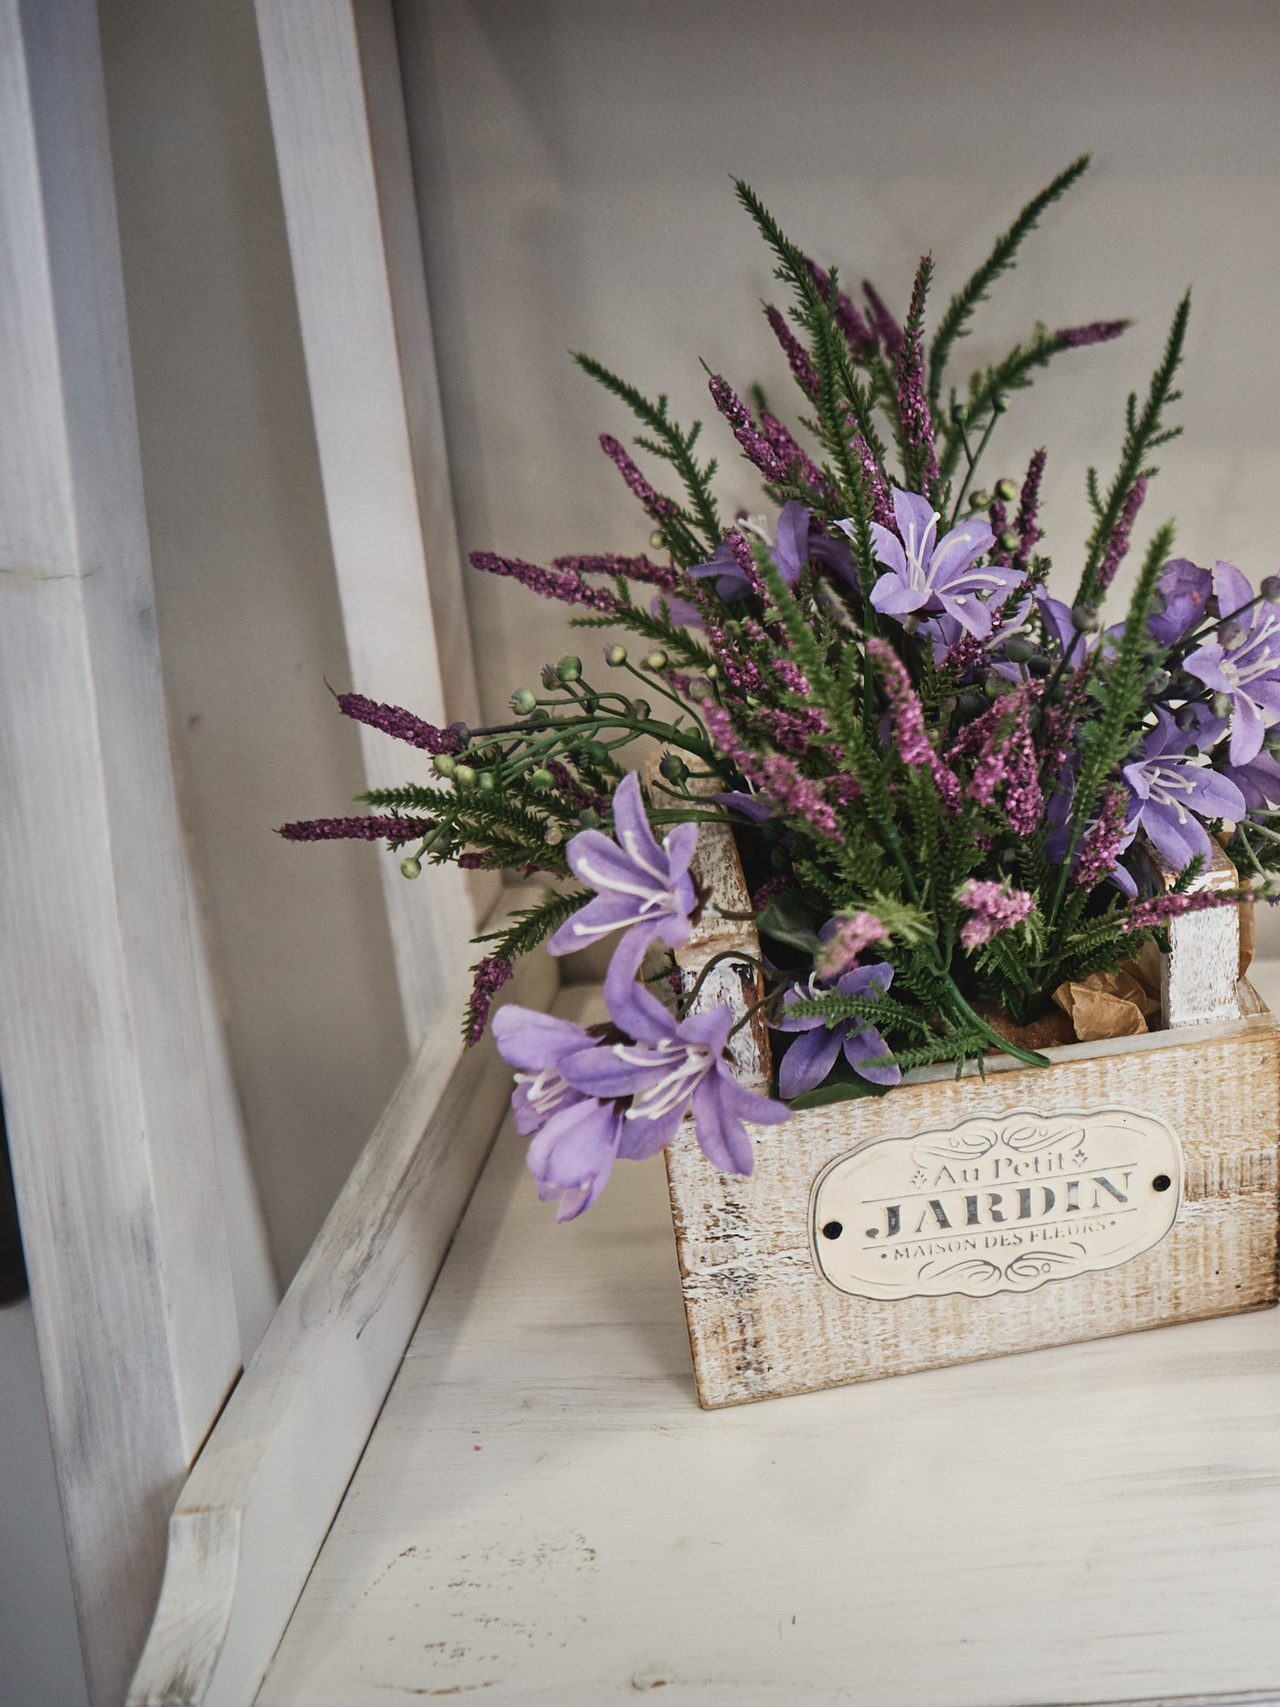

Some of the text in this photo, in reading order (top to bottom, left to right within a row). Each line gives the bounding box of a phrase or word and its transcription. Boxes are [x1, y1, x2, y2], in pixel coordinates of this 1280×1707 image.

[934, 1152, 1065, 1186] Au Petit
[865, 1171, 1133, 1239] JARDIN
[894, 1220, 1106, 1261] MAISON DES FLEURS
